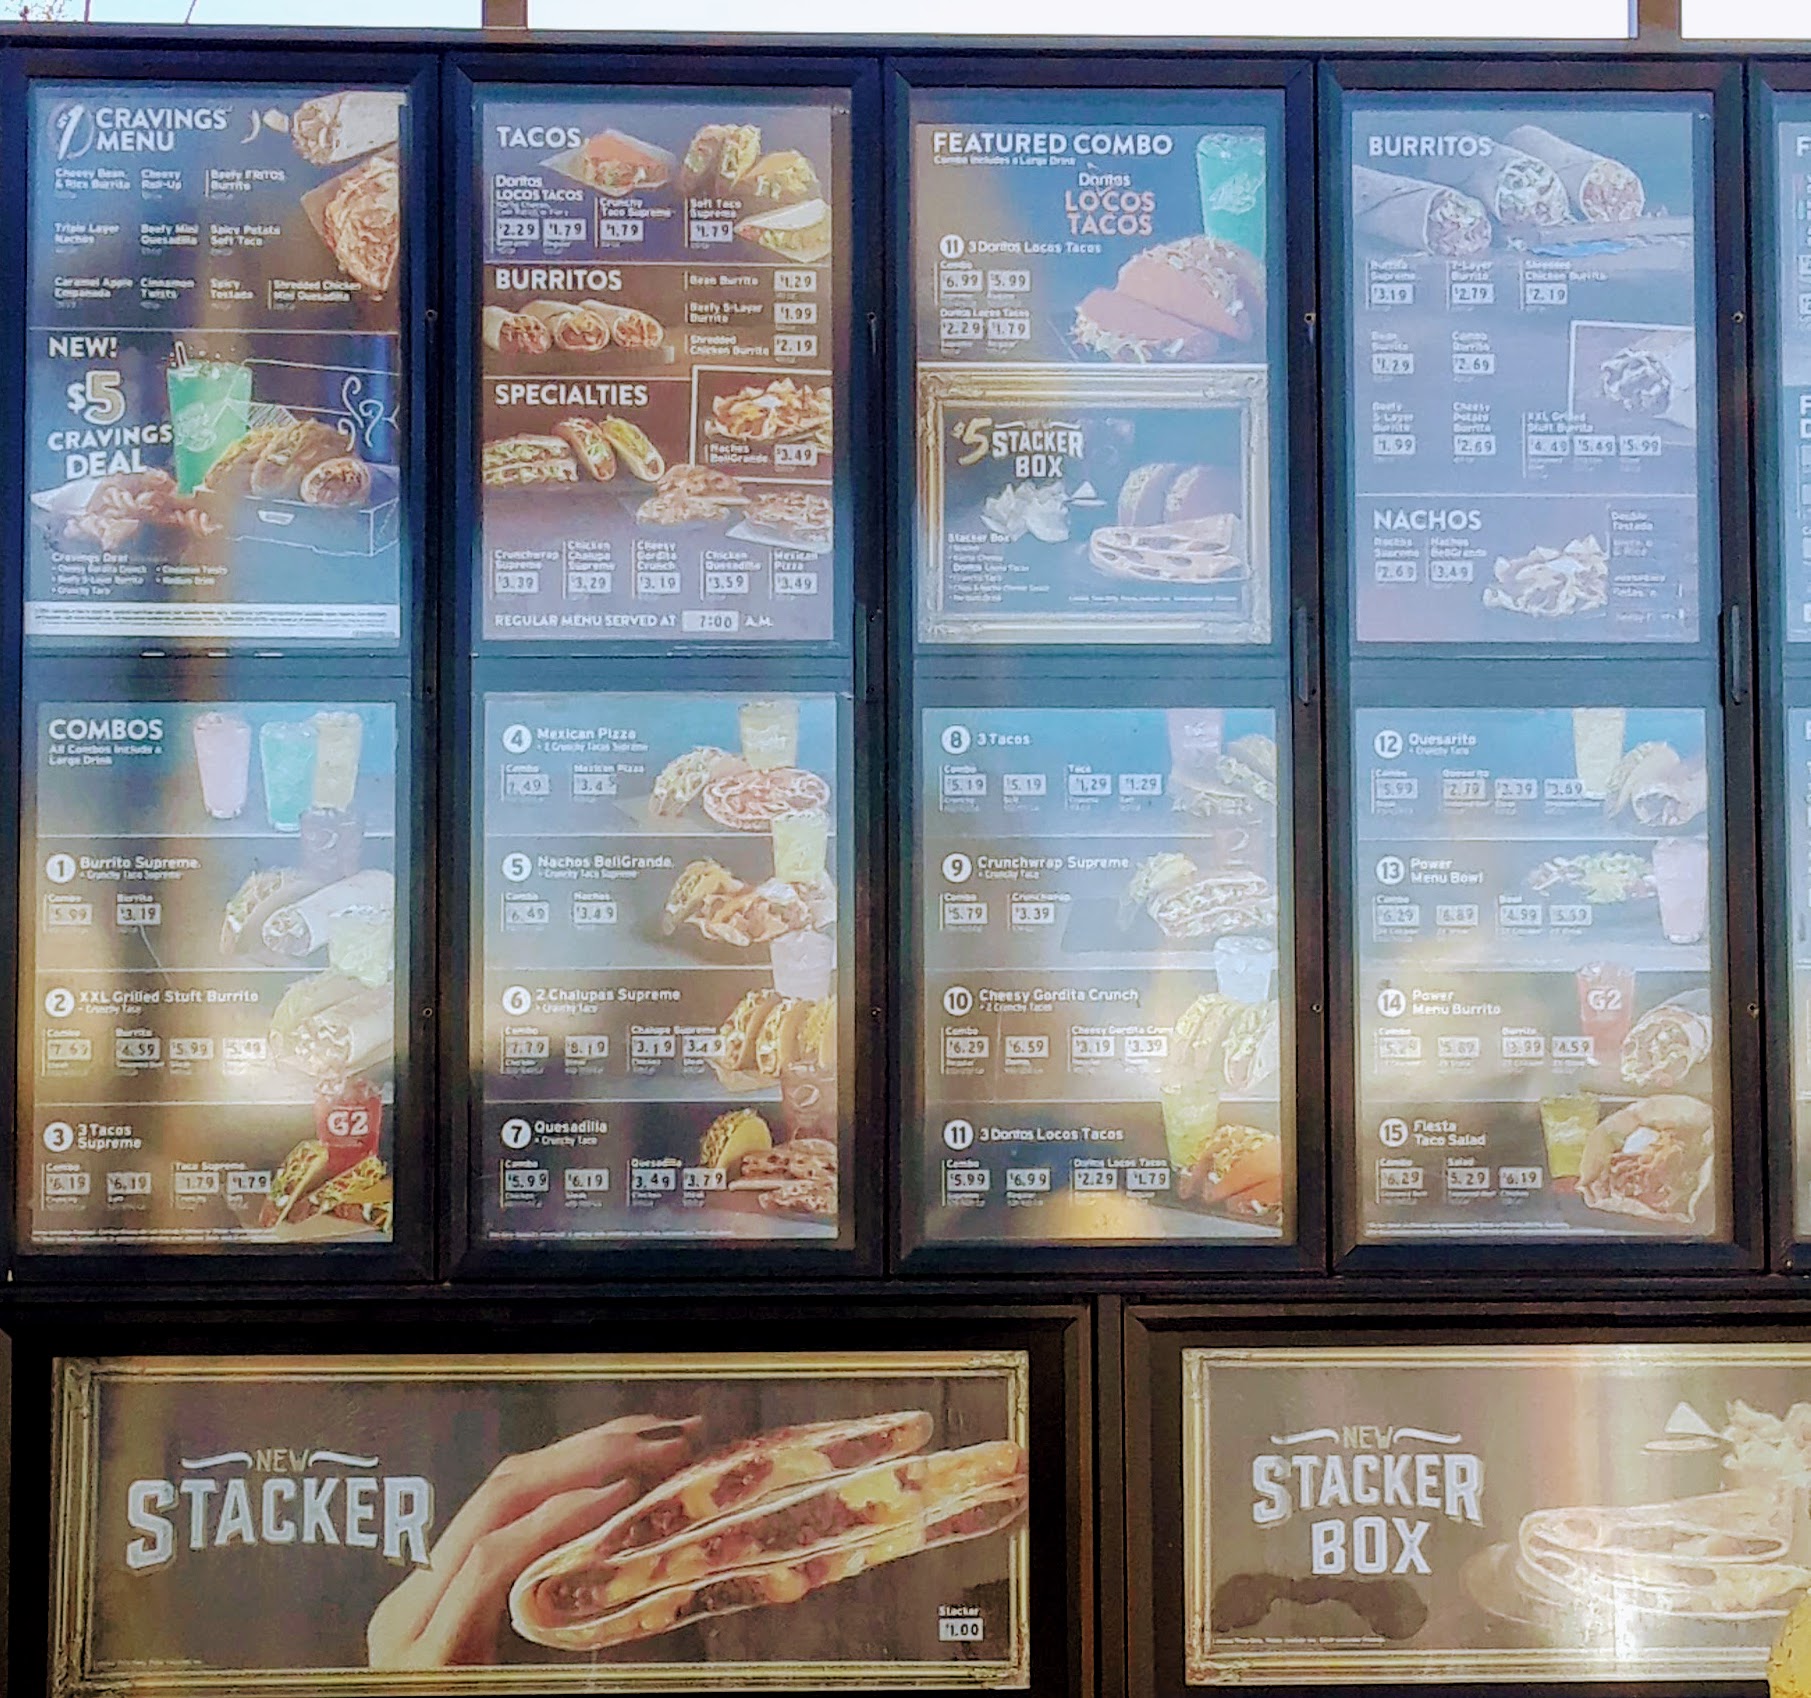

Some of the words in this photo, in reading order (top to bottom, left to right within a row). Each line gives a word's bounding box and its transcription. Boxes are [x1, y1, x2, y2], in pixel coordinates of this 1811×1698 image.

[96, 108, 226, 130] CRAVINGS
[96, 132, 174, 151] MENU
[497, 127, 581, 148] TACOS
[933, 133, 1067, 154] FEATURED
[1074, 134, 1173, 155] COMBO
[1369, 136, 1493, 157] BURRITOS
[497, 190, 540, 200] LOCOS
[542, 190, 584, 201] TACOS
[1065, 191, 1155, 212] LOCOS
[1067, 214, 1152, 235] TACOS
[978, 242, 1021, 253] Doritos
[1024, 242, 1062, 253] Locos
[1065, 242, 1101, 253] Tacos
[496, 270, 622, 291] BURRITOS
[49, 337, 118, 358] NEW!
[66, 371, 126, 425] $5
[495, 384, 649, 406] SPECIALTIES
[48, 424, 173, 451] CRAVINGS
[992, 430, 1083, 458] STACKER
[66, 450, 148, 479] DEAL
[1016, 454, 1062, 478] BOX
[1374, 510, 1482, 530] NACHOS
[495, 615, 558, 627] REGULAR
[562, 615, 602, 627] MENU
[605, 615, 656, 628] SERVED
[659, 615, 676, 627] AT
[48, 719, 163, 740] COMBOS
[537, 728, 593, 739] Mexican
[598, 728, 636, 739] Pizza
[978, 734, 987, 745] 3
[989, 734, 1030, 745] Tacos
[1380, 736, 1397, 752] 12
[1409, 734, 1477, 746] Quesarito
[80, 857, 130, 869] Burrito
[135, 857, 199, 870] Supreme
[538, 855, 590, 867] Nachos
[594, 856, 672, 868] BellGrande
[977, 856, 1063, 870] Crunchwrap
[1067, 856, 1129, 870] Supreme
[1410, 859, 1451, 870] Power
[1381, 862, 1399, 878] 13
[1410, 872, 1446, 883] Menu
[1450, 872, 1483, 883] Bowl
[79, 991, 110, 1002] XXL
[112, 991, 159, 1003] Grilled
[207, 991, 259, 1002] Burrito
[536, 990, 547, 1000] 2
[549, 989, 613, 1002] Chalupas
[618, 989, 681, 1002] Supreme
[949, 993, 968, 1009] 10
[980, 990, 1030, 1003] Cheesy
[1033, 989, 1085, 1001] Gordita
[1089, 989, 1139, 1001] Crunch
[1383, 994, 1400, 1011] 14
[1412, 990, 1454, 1001] Power
[1589, 989, 1622, 1010] G2
[1413, 1004, 1449, 1015] Menu
[1452, 1003, 1500, 1015] Burrito
[78, 1124, 87, 1136] 3
[89, 1124, 131, 1136] Tacos
[327, 1111, 369, 1136] G2
[535, 1121, 608, 1134] Quesadilla
[1413, 1120, 1456, 1132] Fiesta
[951, 1127, 966, 1143] 11
[980, 1129, 989, 1140] 3
[1037, 1128, 1078, 1140] Locos
[1082, 1128, 1123, 1140] Tacos
[1385, 1125, 1401, 1141] 15
[1414, 1135, 1445, 1145] Taco
[1448, 1135, 1486, 1146] Salad
[78, 1137, 142, 1150] Supreme
[1342, 1426, 1394, 1450] NEW
[256, 1449, 309, 1472] NEW
[1252, 1453, 1485, 1527] STACKER
[126, 1476, 434, 1577] STACKER
[1311, 1516, 1434, 1576] BOX
